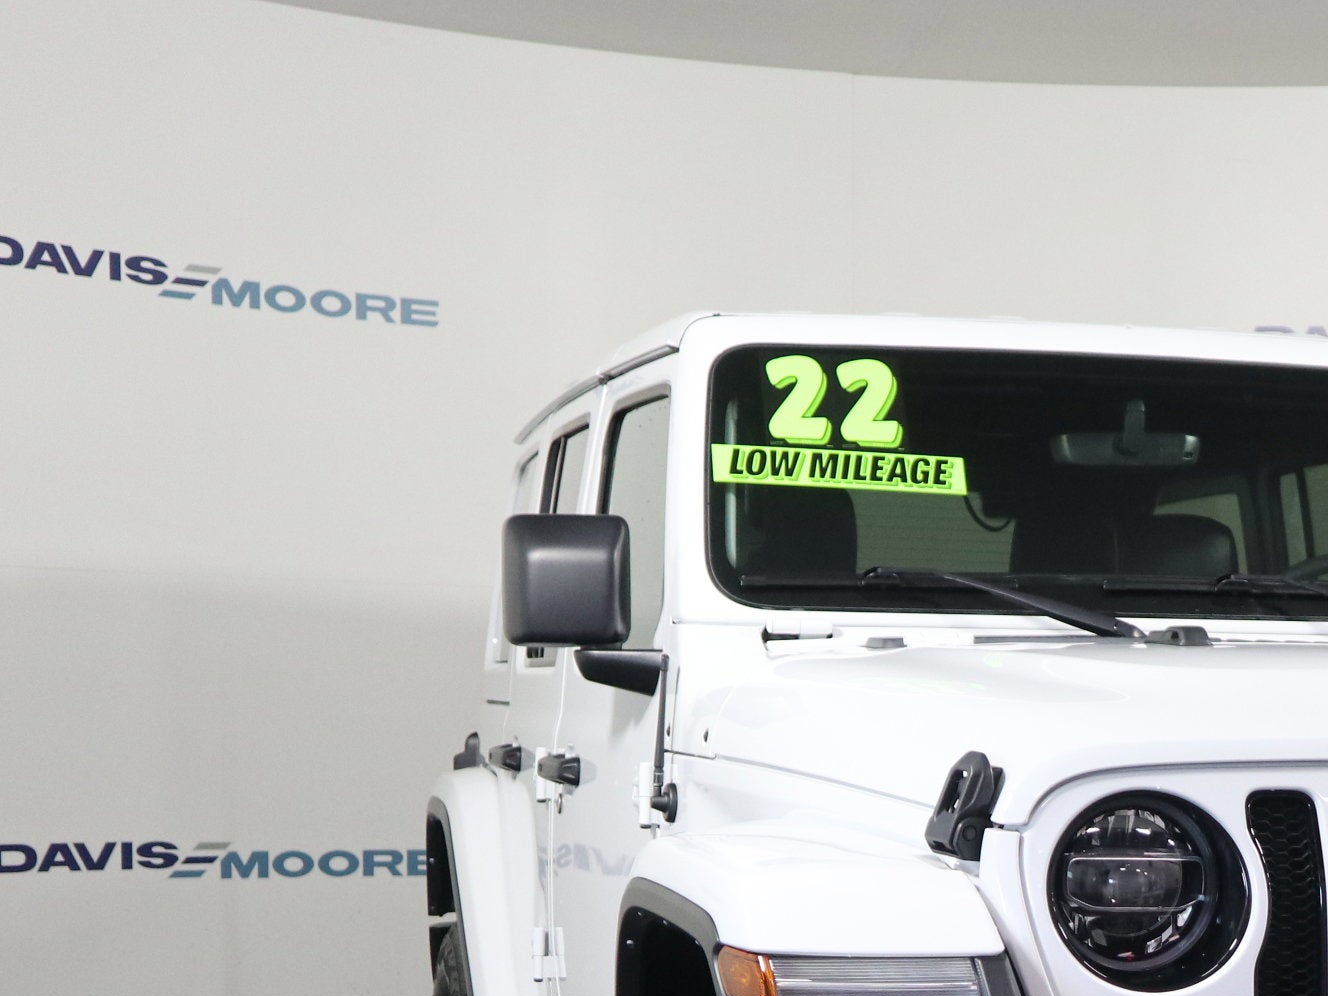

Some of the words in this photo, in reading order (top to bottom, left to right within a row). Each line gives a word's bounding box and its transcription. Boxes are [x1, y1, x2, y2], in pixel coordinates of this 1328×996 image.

[211, 278, 439, 327] MOORE
[765, 354, 903, 448] 22
[730, 448, 803, 478] LOW
[808, 452, 952, 487] MILEAGE
[0, 841, 179, 873] DAVIS
